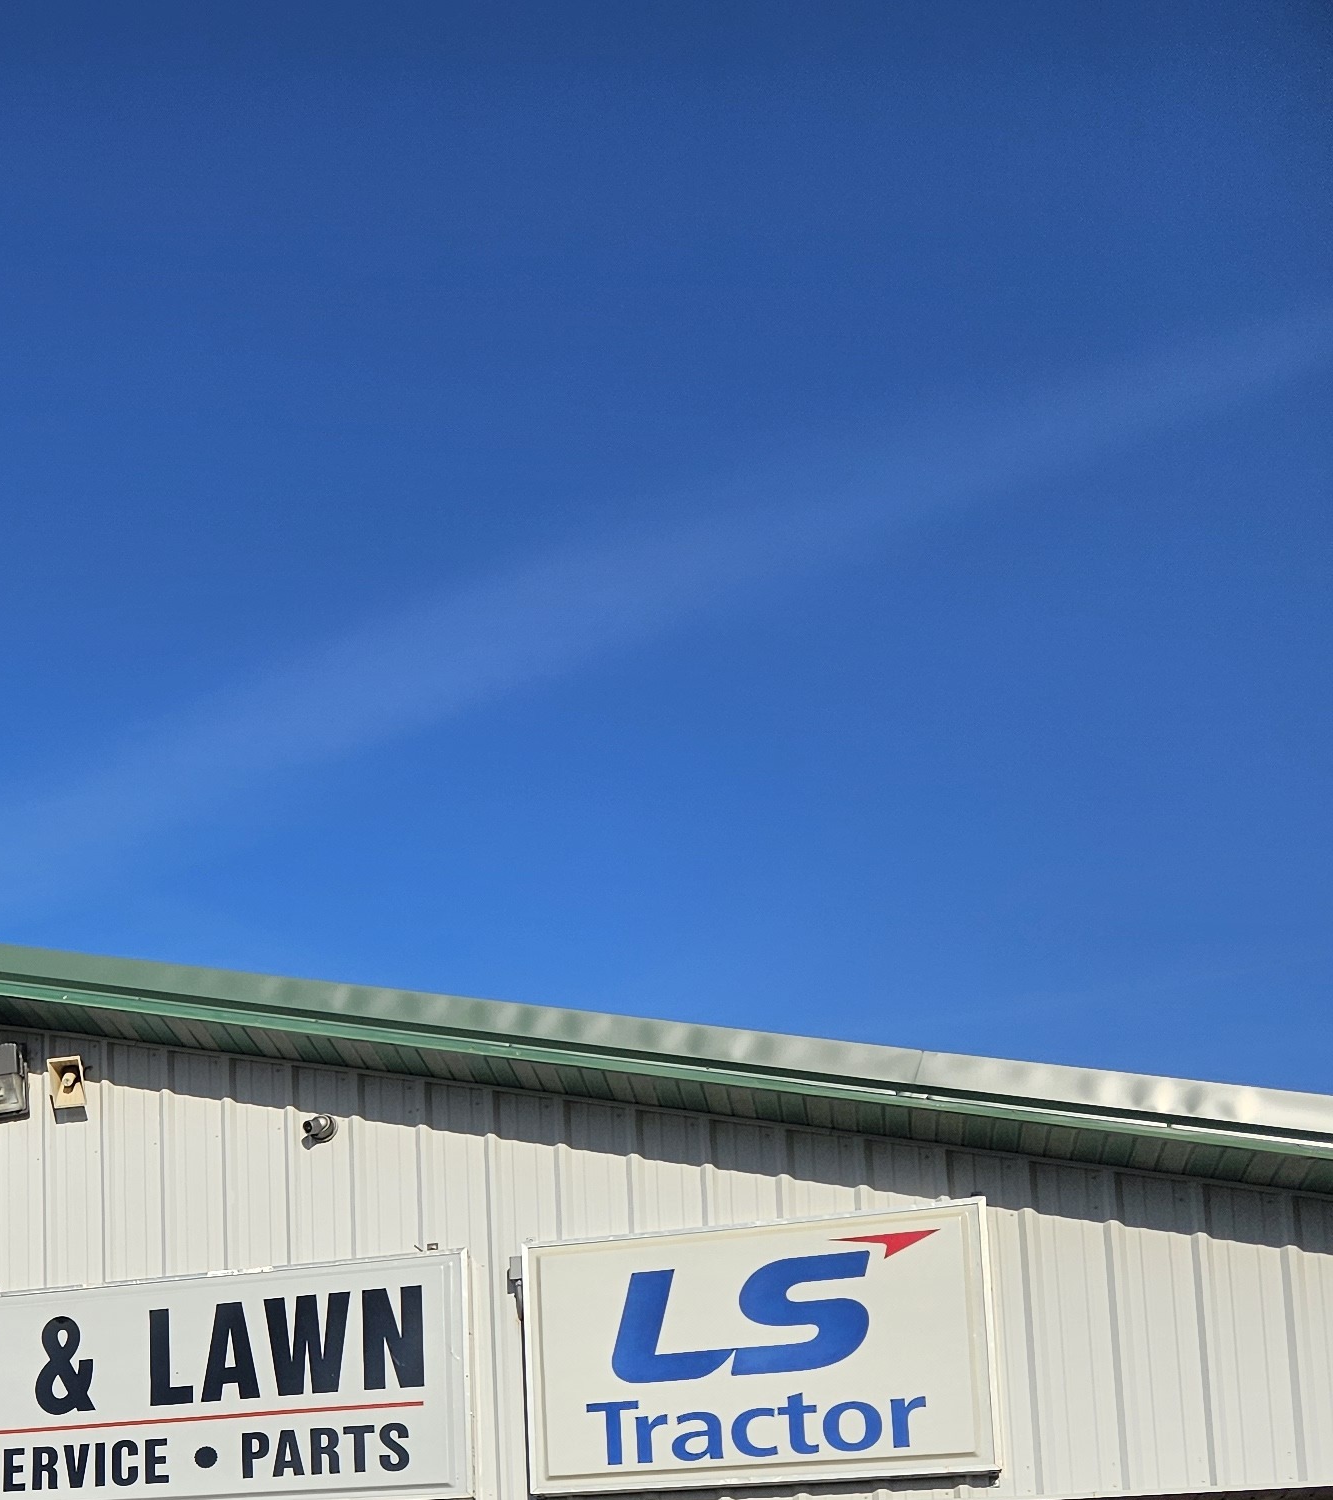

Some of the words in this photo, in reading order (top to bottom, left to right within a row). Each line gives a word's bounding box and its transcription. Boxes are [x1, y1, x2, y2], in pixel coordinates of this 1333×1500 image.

[35, 1316, 96, 1415] &
[149, 1285, 425, 1406] LAWN
[612, 1250, 870, 1383] LS
[241, 1423, 410, 1479] PARTS
[586, 1392, 926, 1466] Tractor
